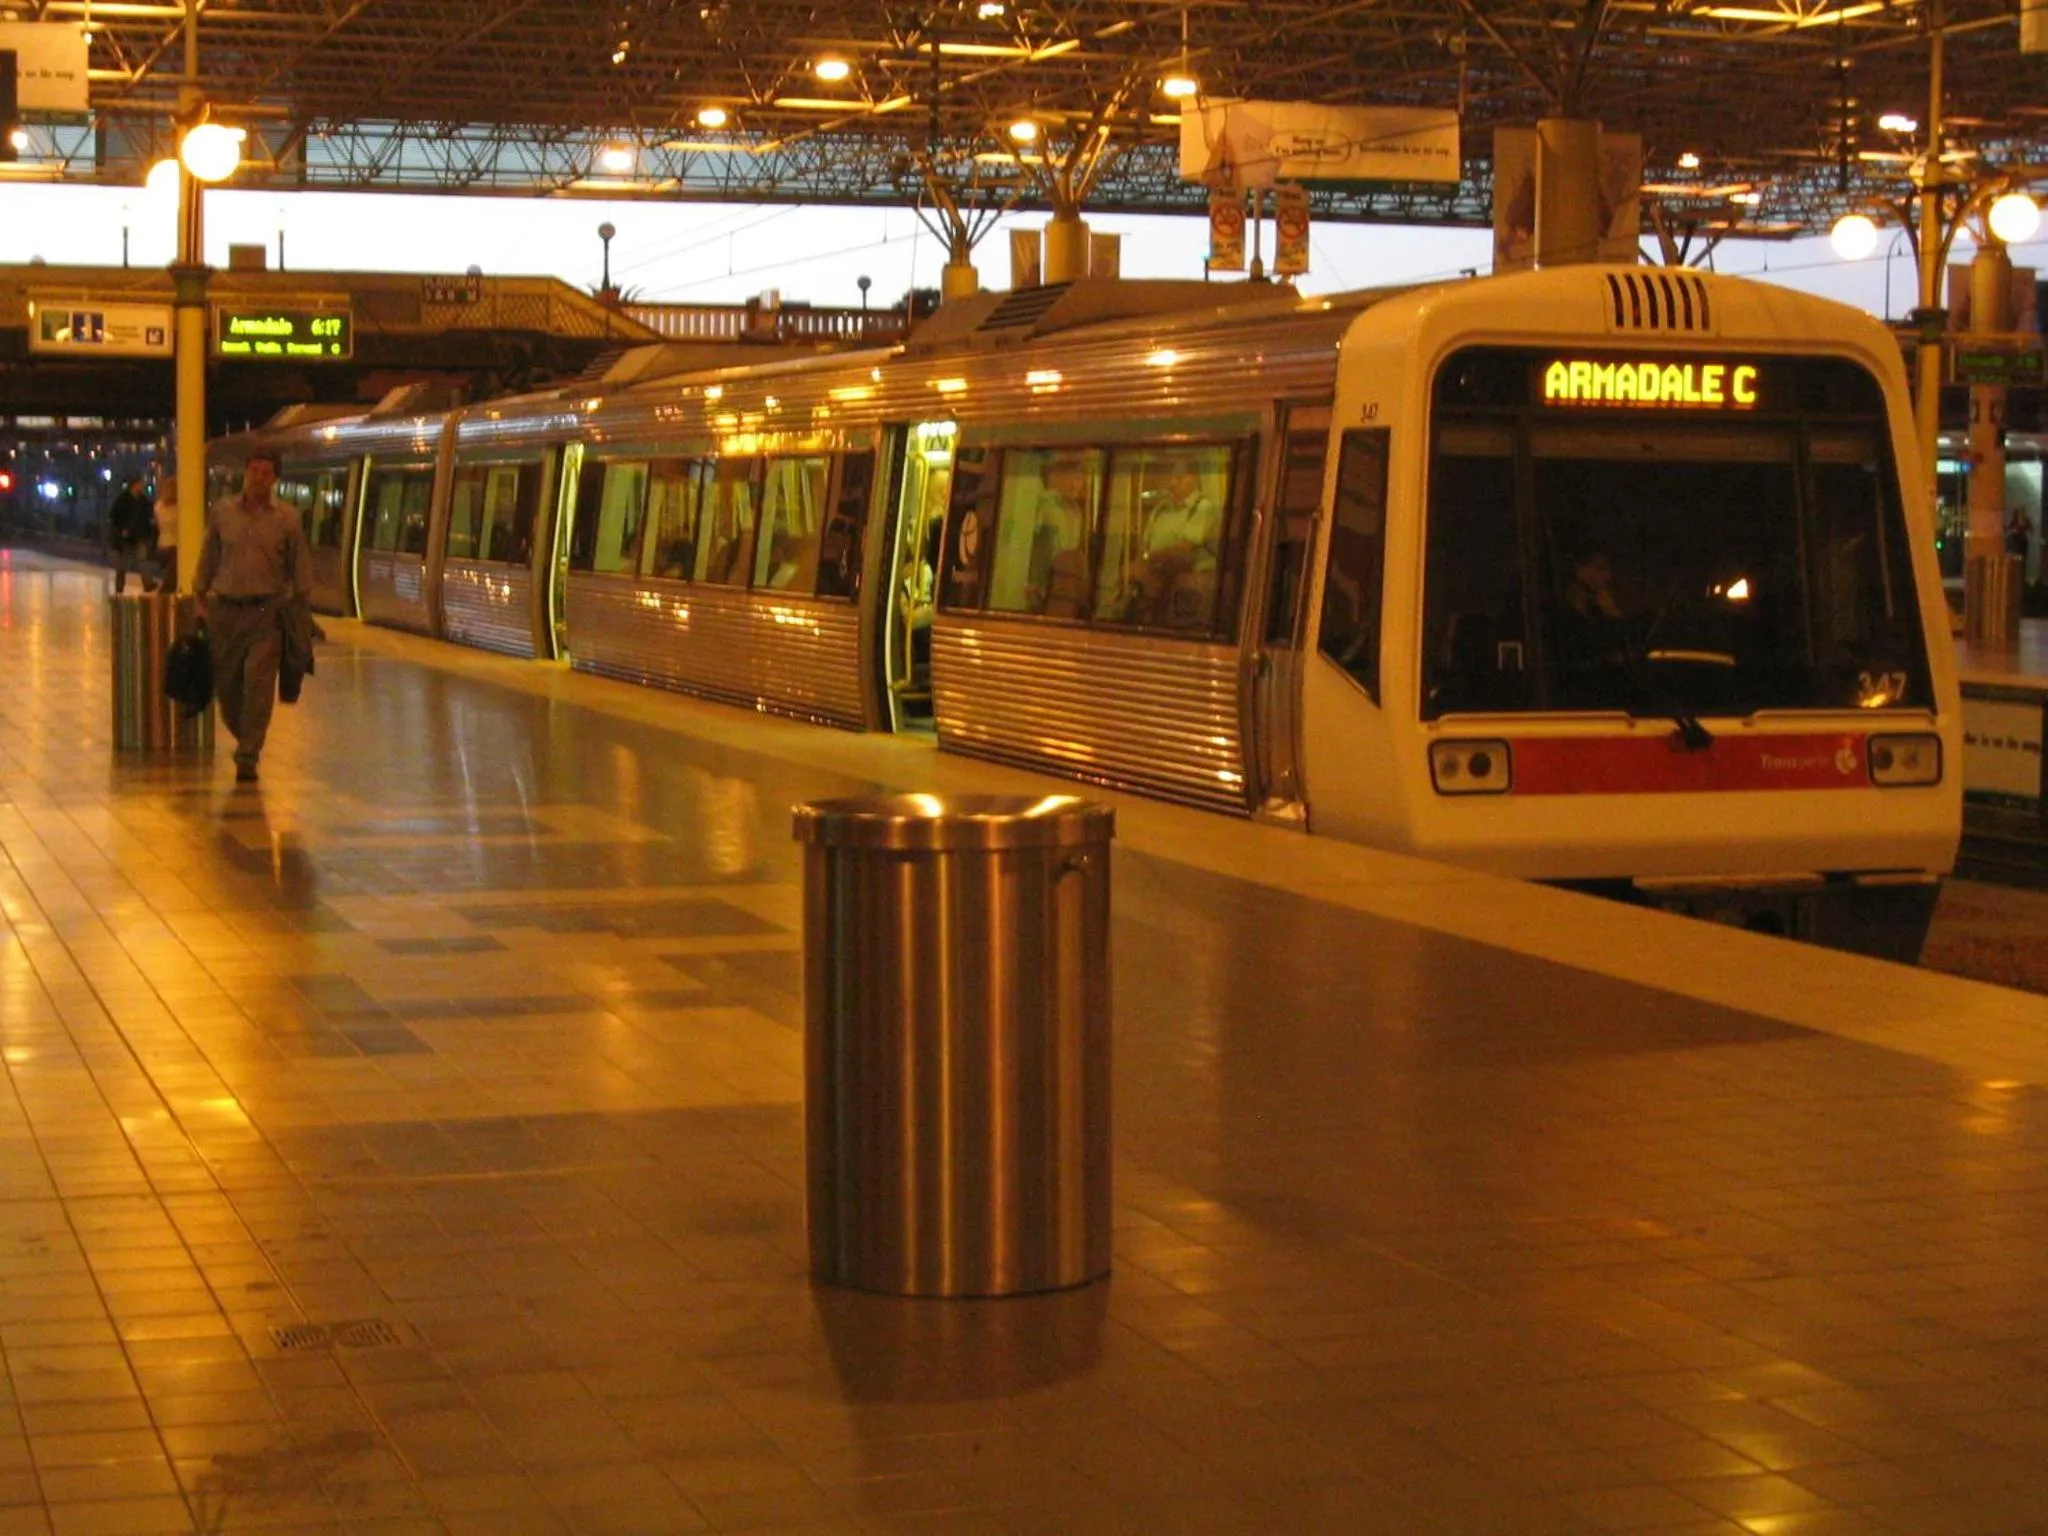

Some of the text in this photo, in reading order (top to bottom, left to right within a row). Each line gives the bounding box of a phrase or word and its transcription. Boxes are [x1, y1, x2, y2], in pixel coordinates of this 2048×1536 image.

[311, 318, 341, 336] 6:17
[1545, 360, 1756, 403] ARMADALE C
[1858, 672, 1907, 704] 347
